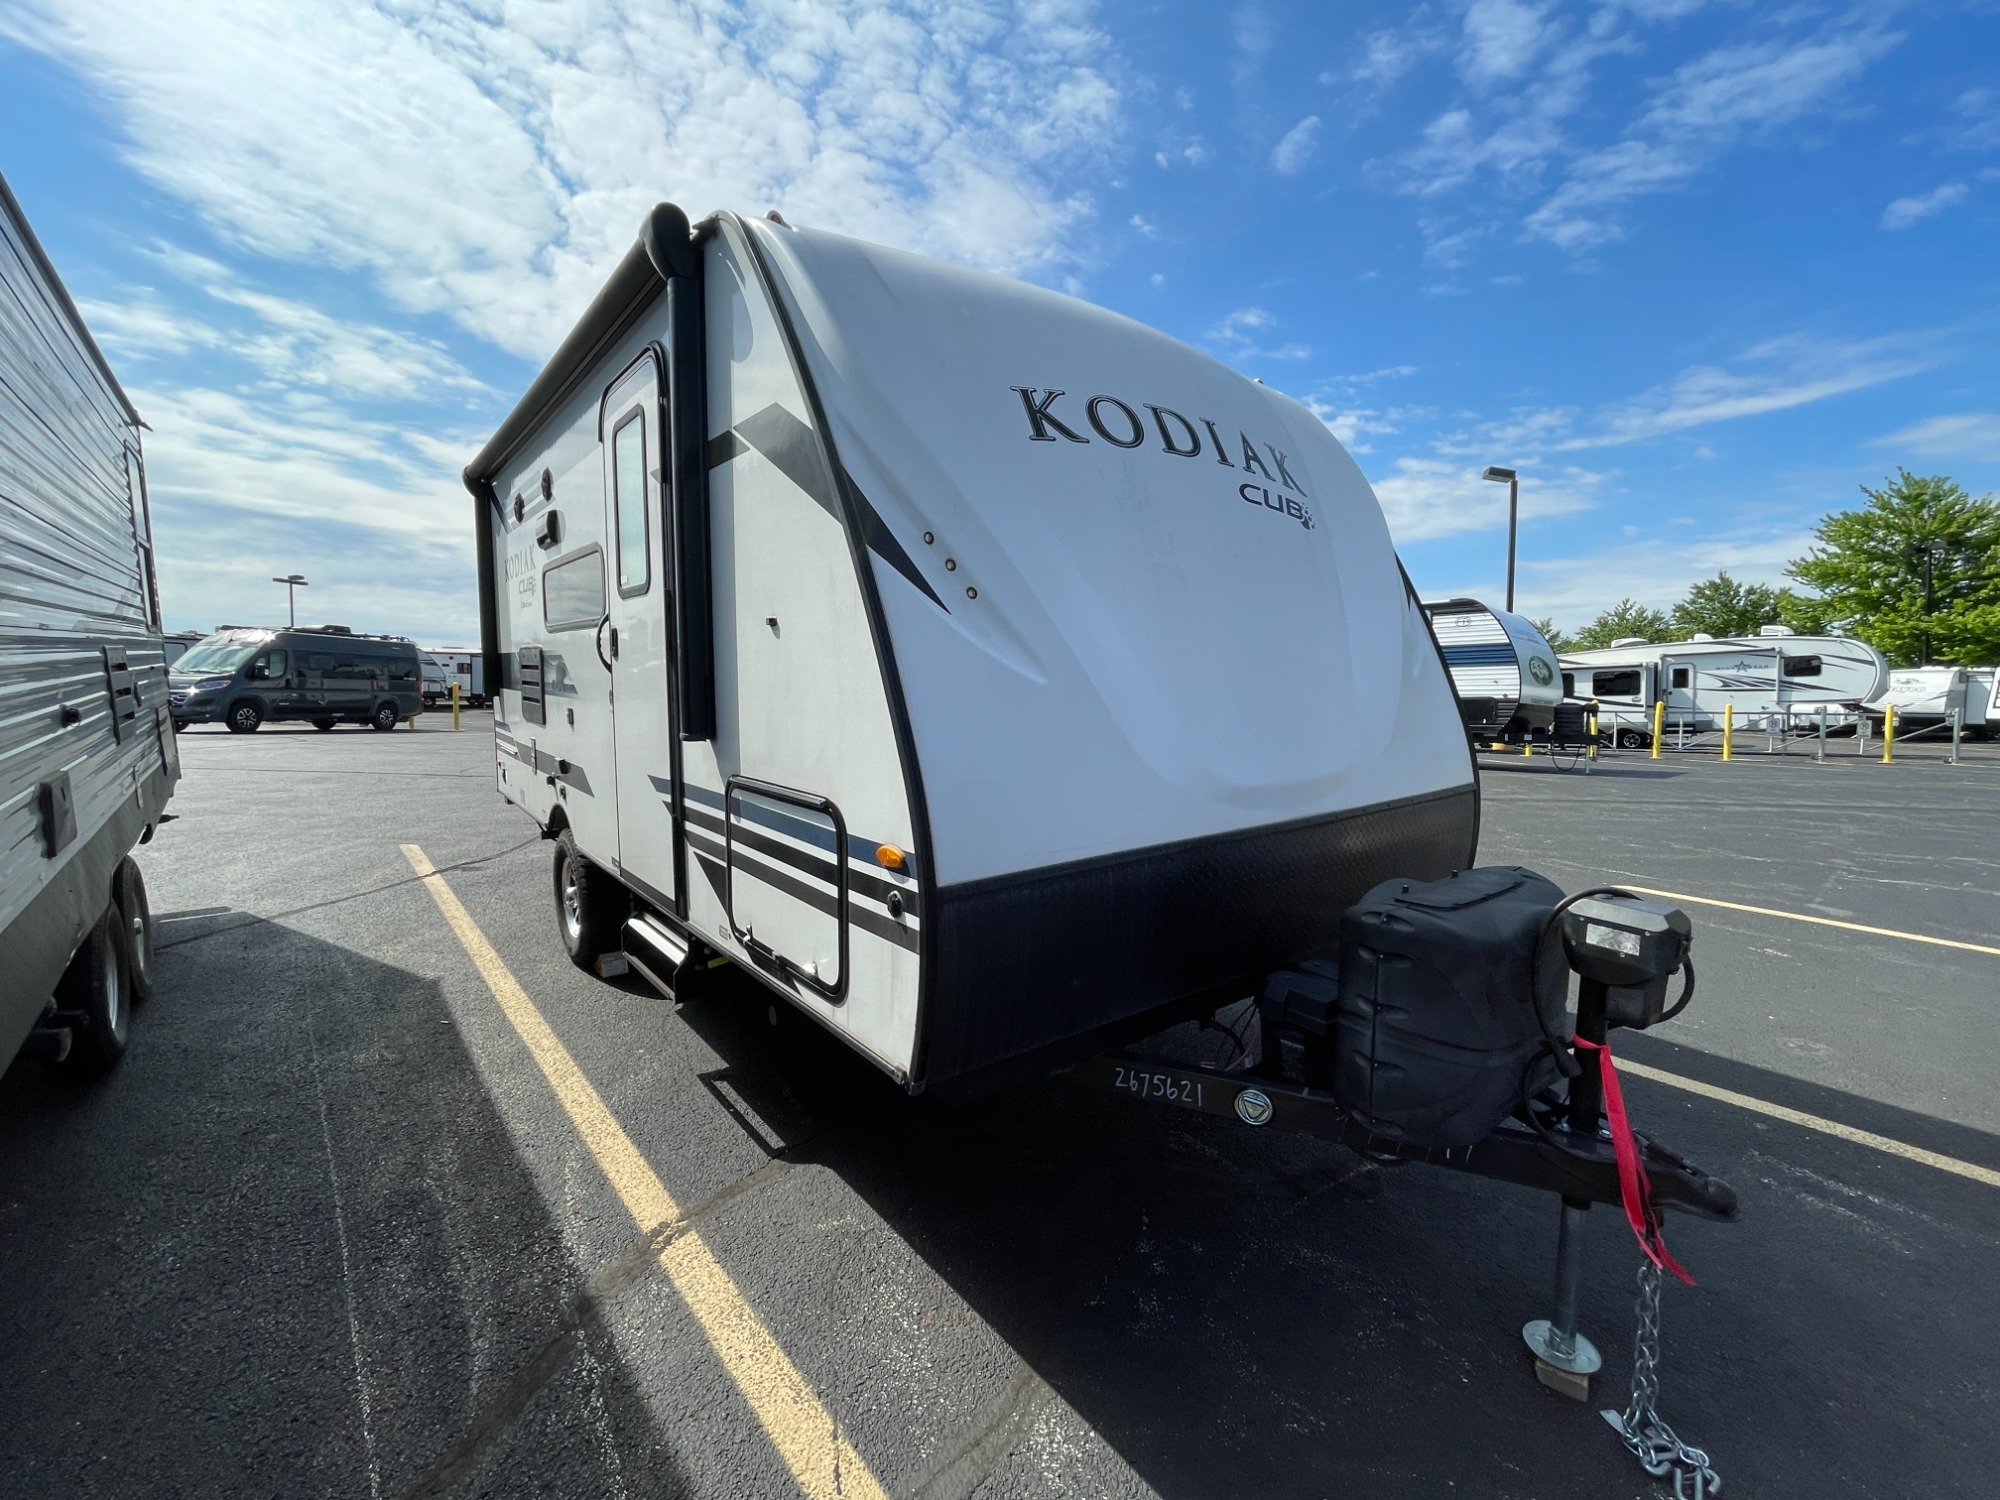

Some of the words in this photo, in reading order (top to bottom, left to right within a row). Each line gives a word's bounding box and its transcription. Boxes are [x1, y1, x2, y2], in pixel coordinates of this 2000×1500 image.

[1009, 385, 1308, 498] KODIAK
[1238, 482, 1305, 521] CUB
[504, 544, 536, 583] KODIAK
[1114, 1067, 1202, 1107] 2675621
